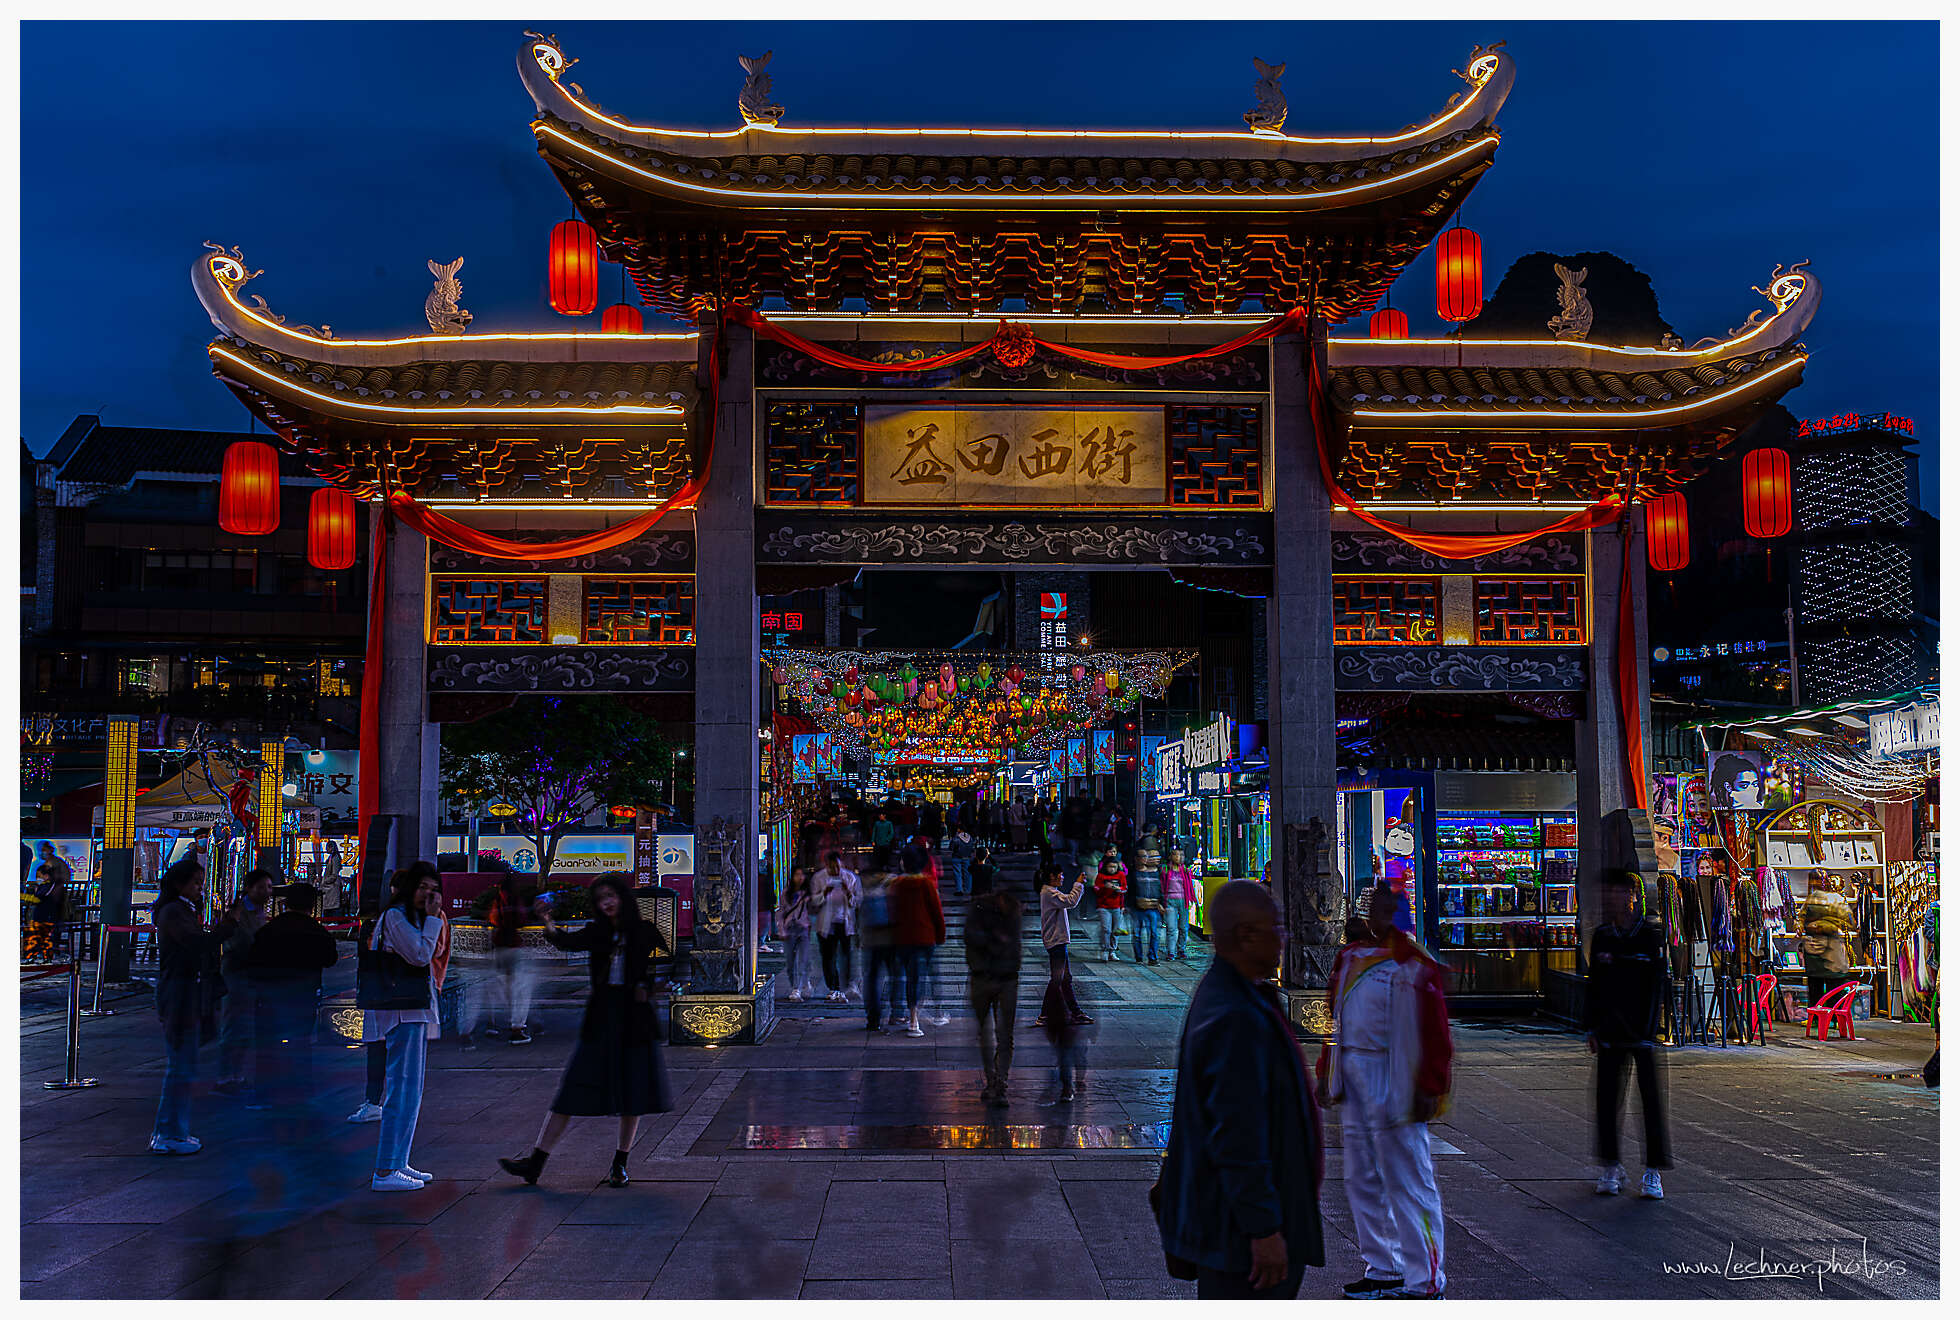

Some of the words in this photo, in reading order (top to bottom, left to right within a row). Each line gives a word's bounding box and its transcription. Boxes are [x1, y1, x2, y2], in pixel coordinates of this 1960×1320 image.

[889, 423, 1137, 486] 益田西街
[761, 611, 802, 630] 南国
[553, 857, 597, 868] GuanPark
[639, 826, 651, 884] 一元抽签
